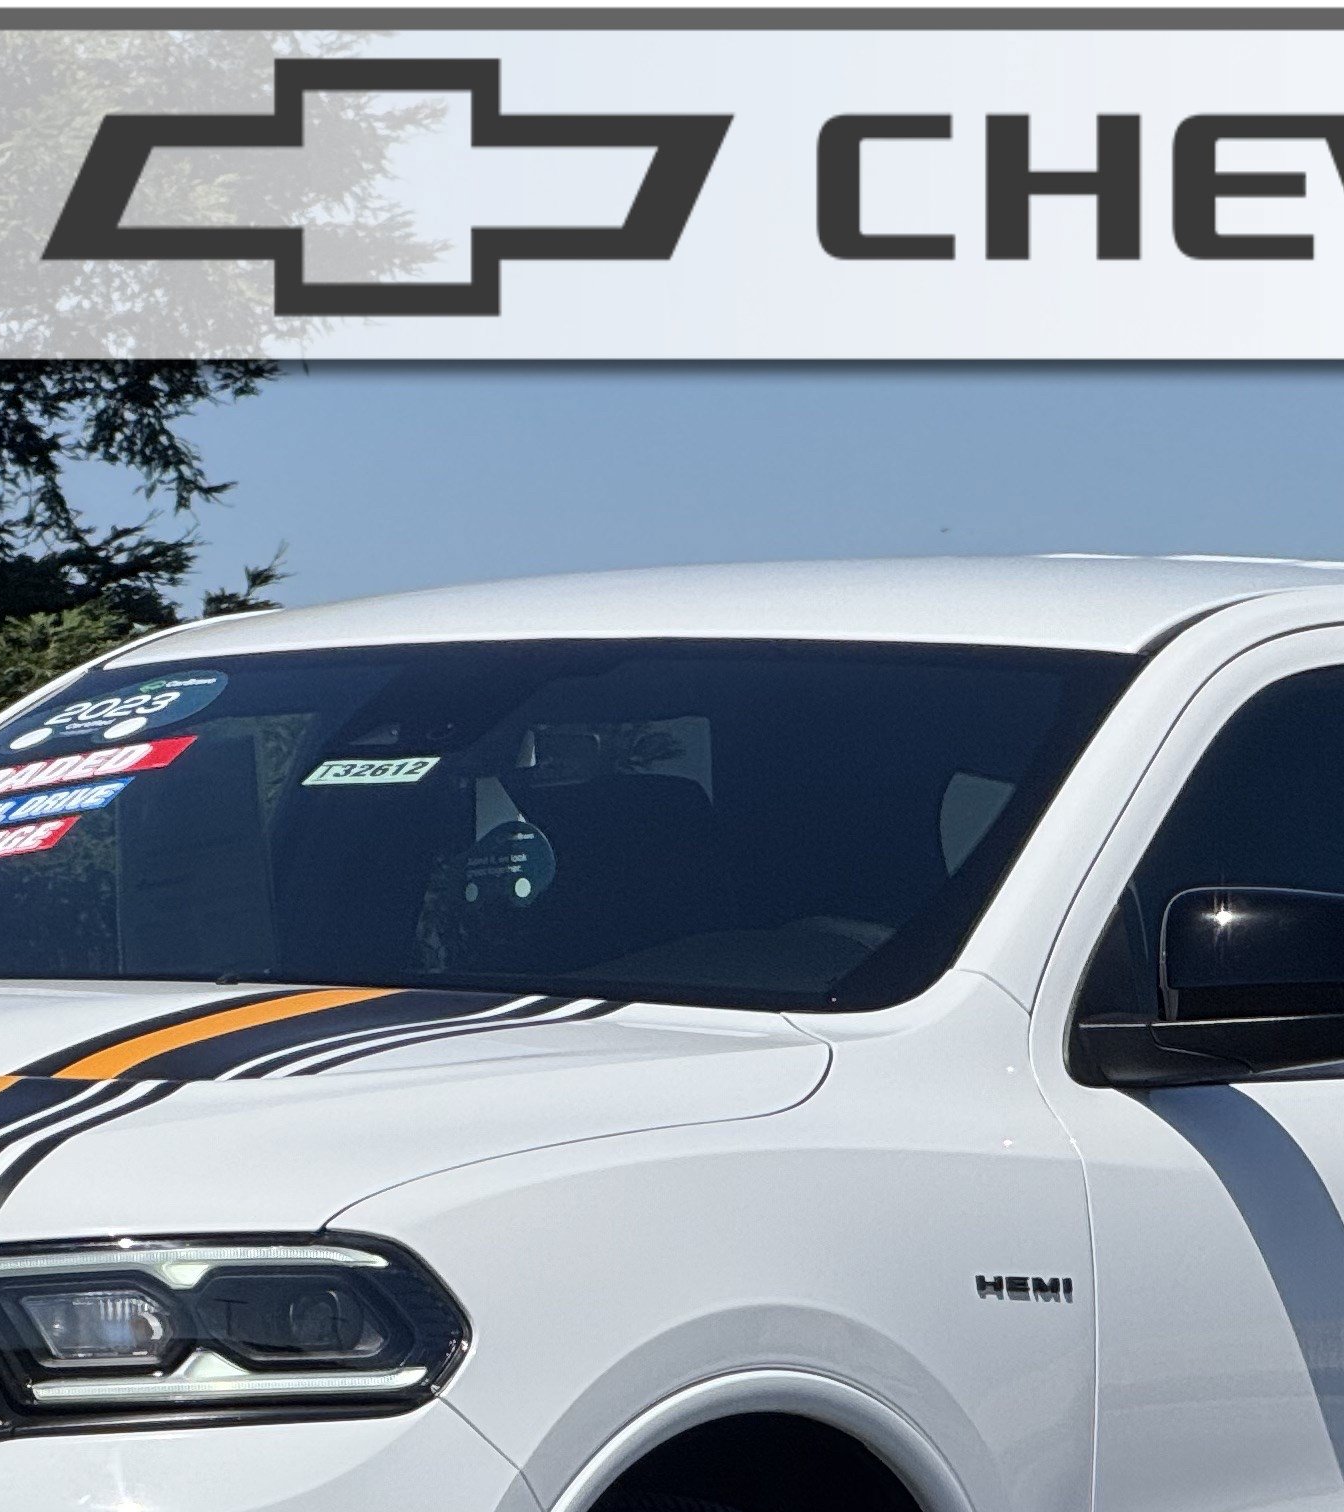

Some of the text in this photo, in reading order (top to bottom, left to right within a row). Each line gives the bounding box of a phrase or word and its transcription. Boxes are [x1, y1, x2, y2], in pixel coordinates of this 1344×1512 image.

[44, 691, 181, 726] 2023
[317, 760, 430, 780] T32612
[6, 781, 127, 821] DRIVE
[975, 1275, 1073, 1297] HEMI
